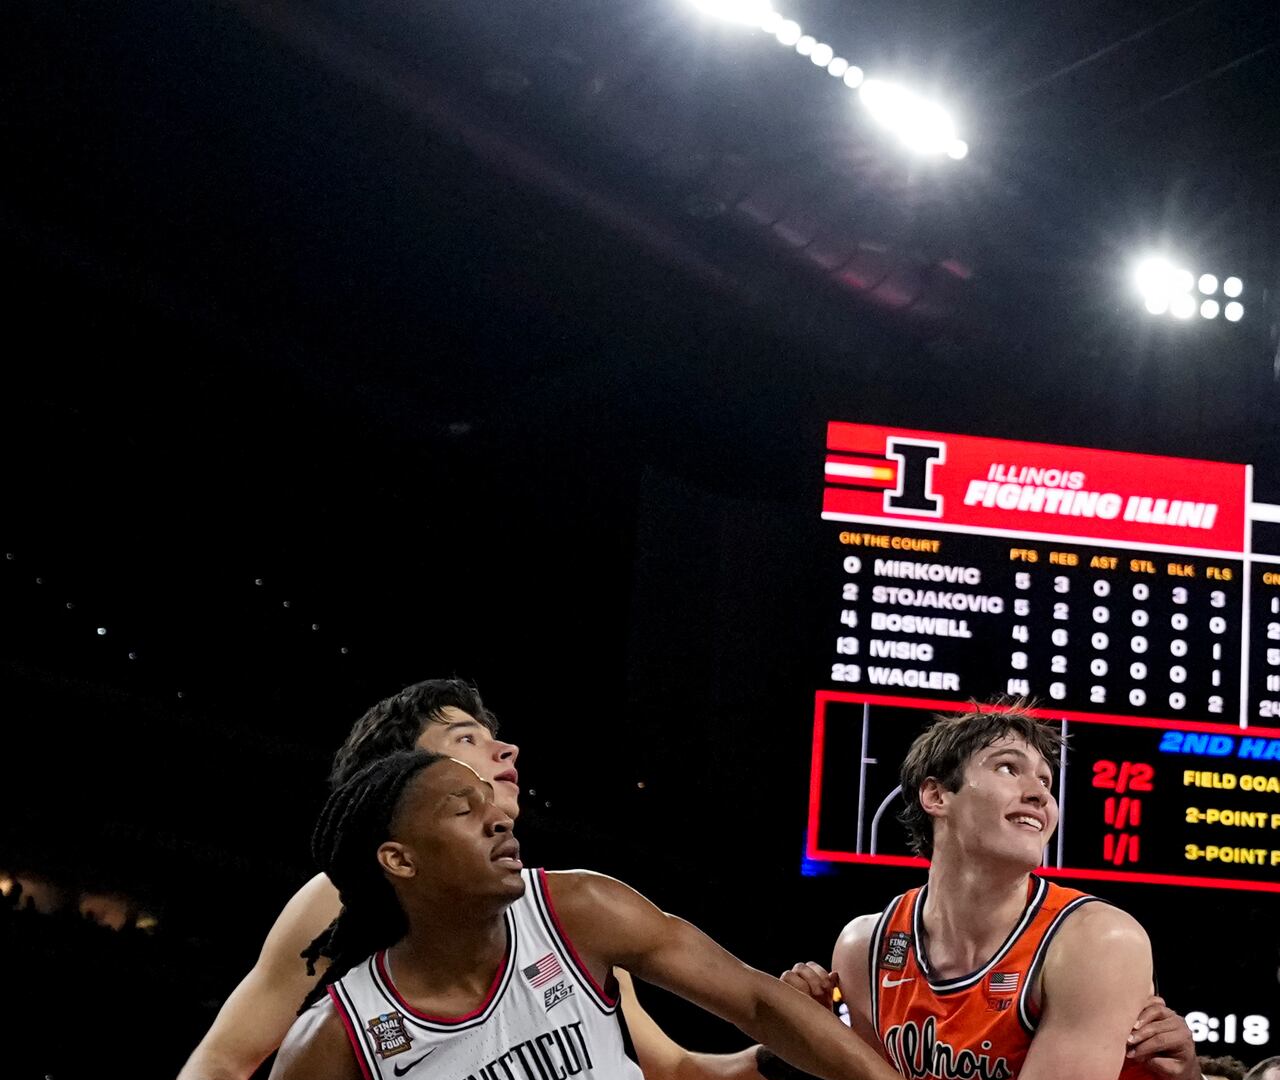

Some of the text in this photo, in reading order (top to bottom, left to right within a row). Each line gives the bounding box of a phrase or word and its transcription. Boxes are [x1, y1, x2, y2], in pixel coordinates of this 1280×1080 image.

[988, 464, 1085, 490] ILLINOIS
[964, 481, 1218, 528] FIGHTING ILLINI
[840, 532, 940, 552] ON THE COURT
[1010, 549, 1232, 580] PTS REB AST STL BLK FLS
[844, 556, 1225, 607] 0 MIRKOVIC 5 3 0 0 3 3
[843, 583, 1226, 634] 2 STOJAKOVIC 5 2 0 0 0 0
[1271, 597, 1279, 613] 1
[841, 610, 1187, 656] 4 BOSWELL 4 6 0 0 0
[837, 637, 1186, 683] 13 IVISIC 8 2 0 0 0
[831, 663, 1223, 713] 23 WAGLER 14 6 2 0 0 2
[1267, 675, 1280, 691] 11
[1159, 731, 1235, 756] 2ND
[1092, 760, 1154, 793] 2/2
[1184, 770, 1236, 789] FIELD
[1105, 797, 1140, 829] 1/1
[1186, 807, 1268, 828] 2-POINT
[1104, 833, 1139, 865] 1/1
[1185, 844, 1267, 864] 3-POINT
[889, 939, 907, 948] FINAL
[885, 954, 903, 963] FOUR
[544, 980, 565, 999] BIG
[544, 985, 575, 1009] EAST
[373, 1019, 399, 1033] FINAL
[382, 1037, 404, 1050] FOUR
